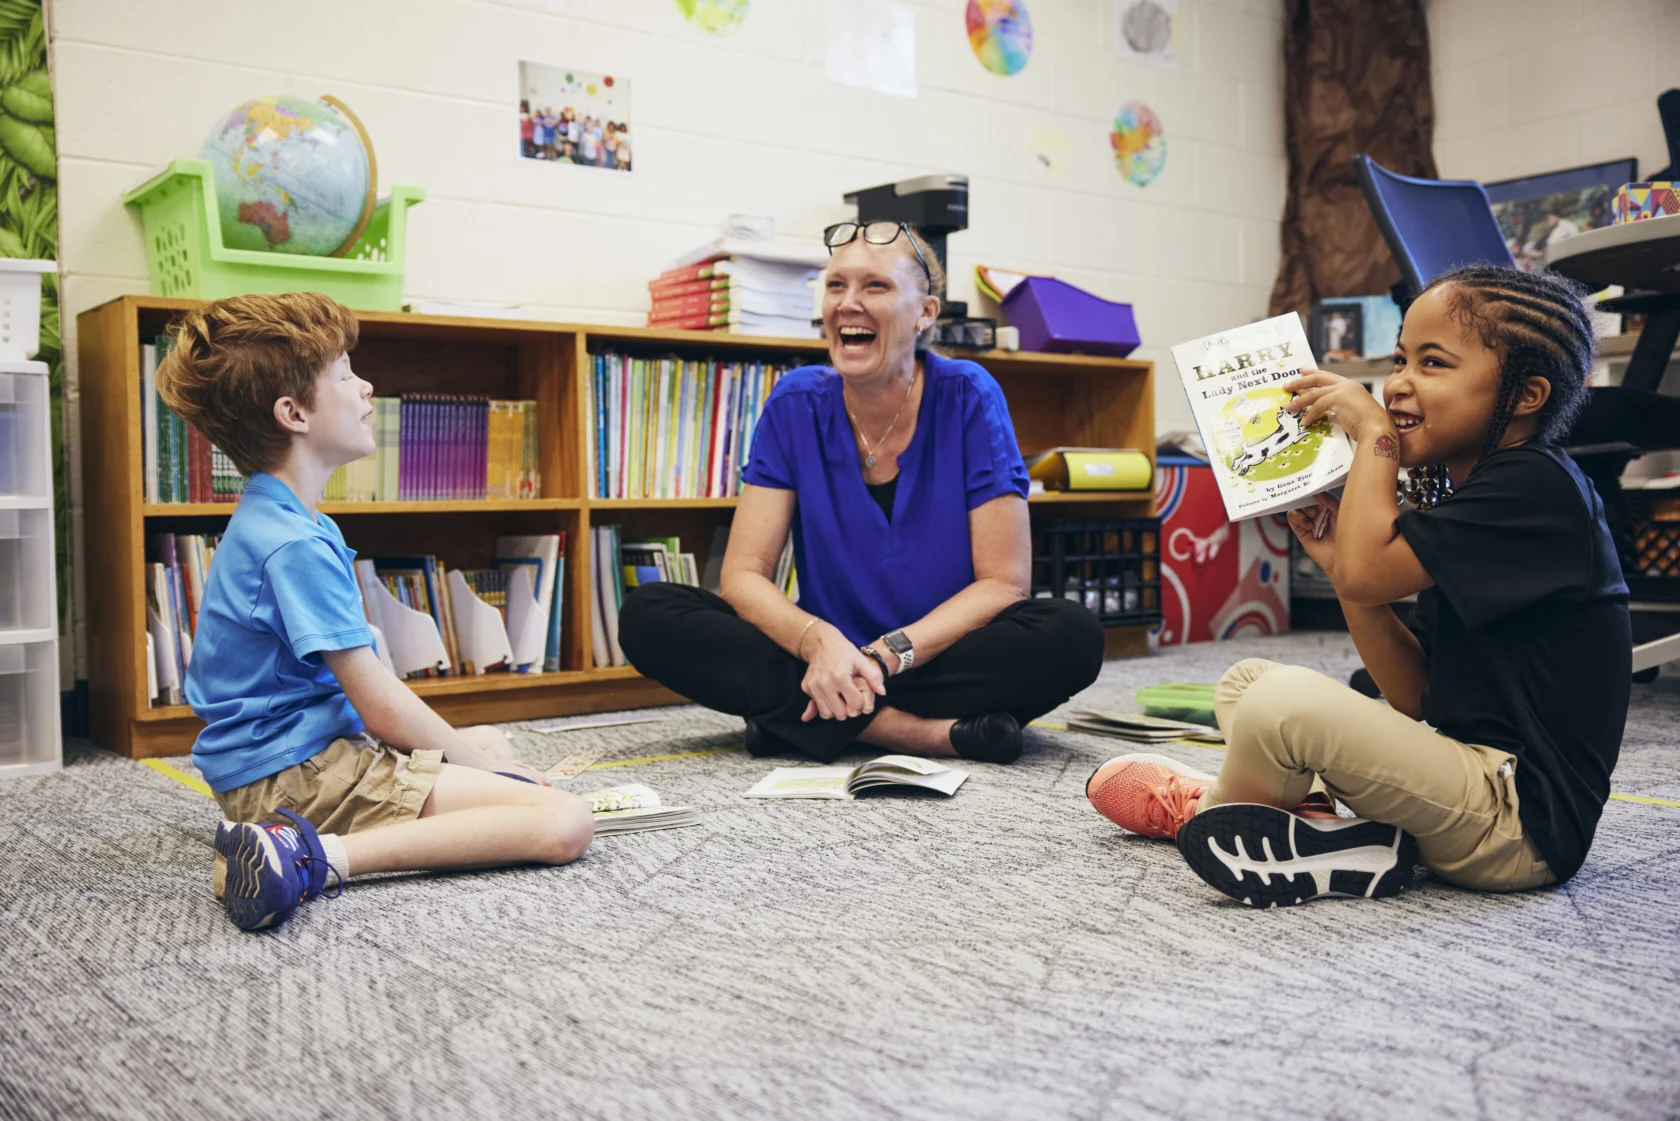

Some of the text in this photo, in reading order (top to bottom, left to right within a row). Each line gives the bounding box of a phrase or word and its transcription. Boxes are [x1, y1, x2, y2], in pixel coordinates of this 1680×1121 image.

[1193, 341, 1293, 381] HARRY
[1202, 367, 1302, 400] Lady Next Door
[1230, 367, 1267, 381] and the
[1277, 480, 1295, 489] Gene
[1238, 499, 1260, 509] Pictures
[1270, 485, 1301, 499] Margaret
